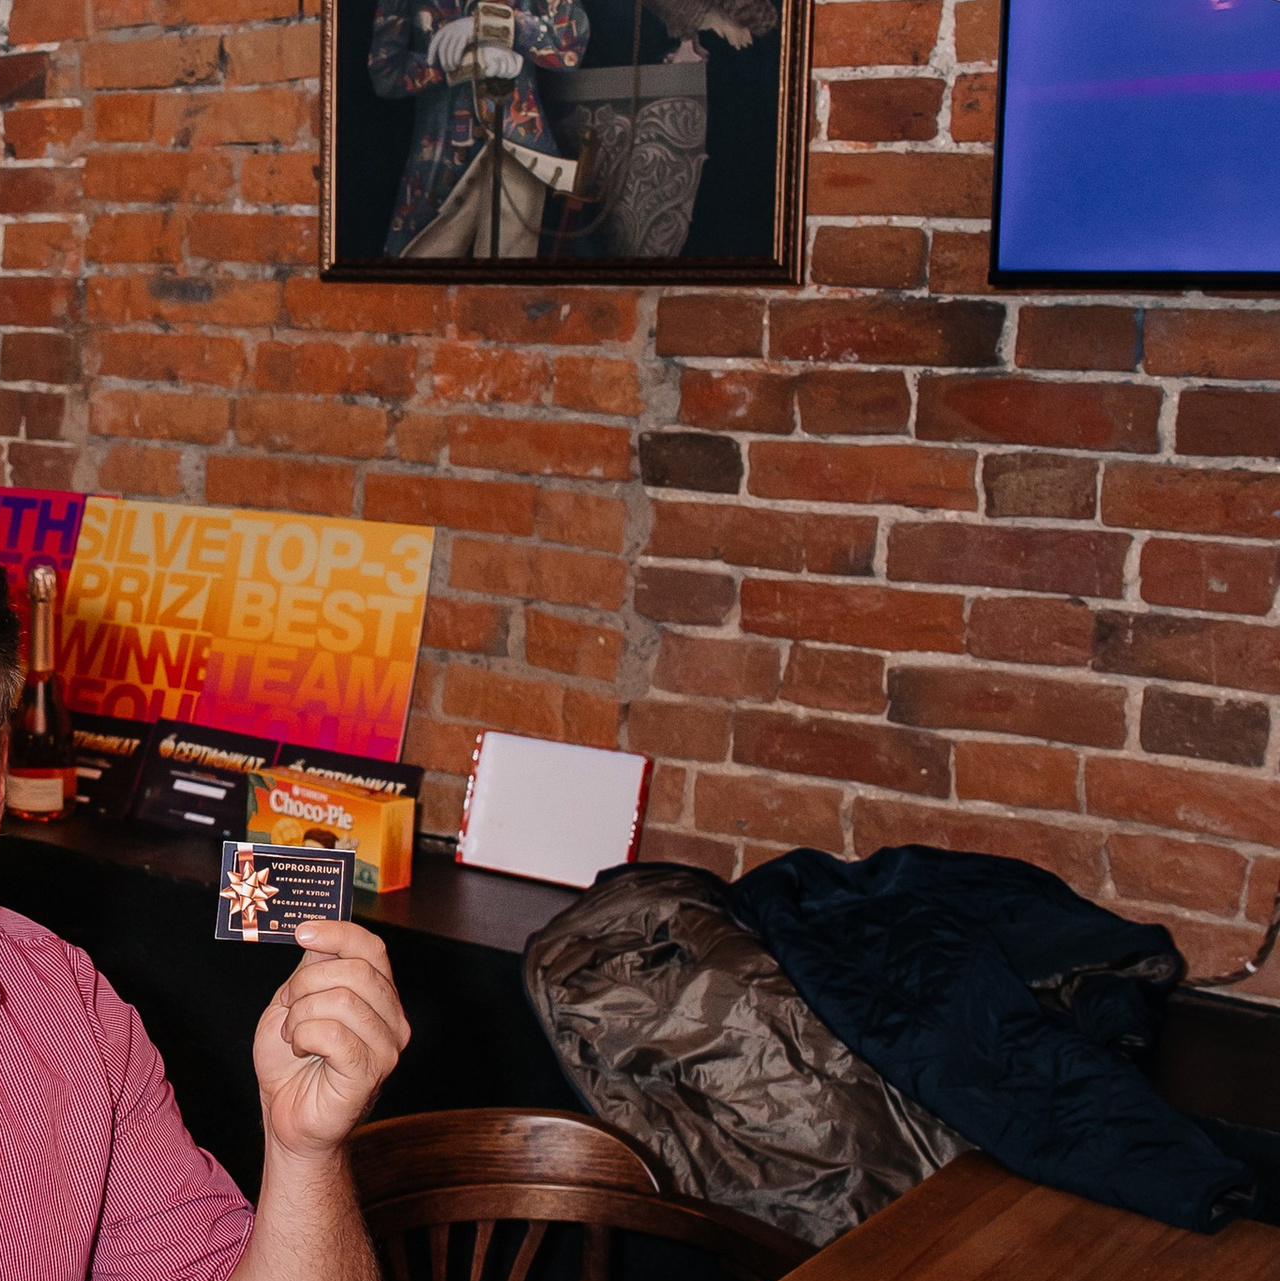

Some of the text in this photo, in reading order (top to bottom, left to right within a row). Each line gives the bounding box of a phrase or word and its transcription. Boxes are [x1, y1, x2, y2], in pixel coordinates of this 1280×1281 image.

[230, 518, 433, 597] TOP-3
[271, 862, 340, 875] VOPROSARIUM
[306, 889, 330, 897] КУПОН
[319, 902, 336, 910] игра
